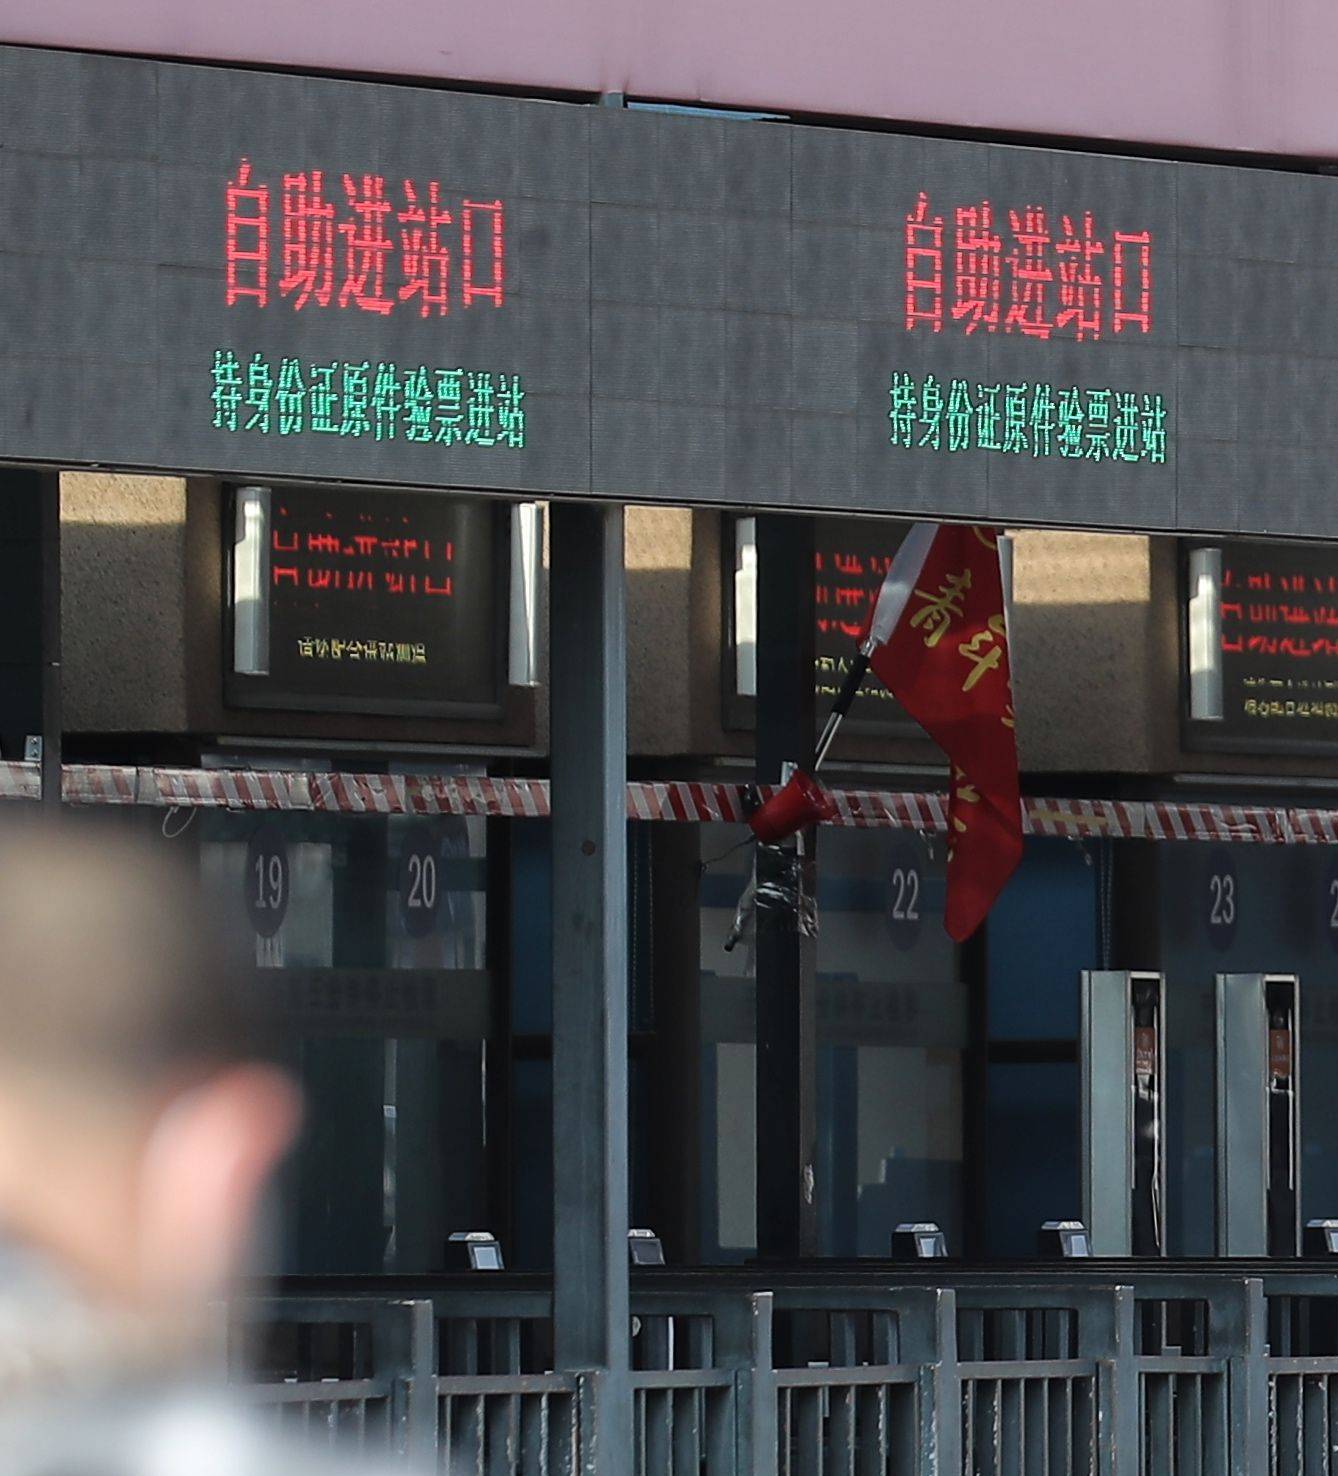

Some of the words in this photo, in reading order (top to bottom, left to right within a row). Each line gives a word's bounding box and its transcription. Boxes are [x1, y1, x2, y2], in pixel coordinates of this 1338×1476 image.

[224, 159, 506, 319] 自助进站口
[903, 190, 1153, 343] 自助进站口
[210, 350, 528, 450] 持身份证原件验票进站
[889, 373, 1168, 465] 持身份证原件验票进站
[254, 853, 284, 910] 19
[407, 853, 436, 909] 20
[891, 868, 919, 922] 22
[1210, 874, 1236, 926] 23
